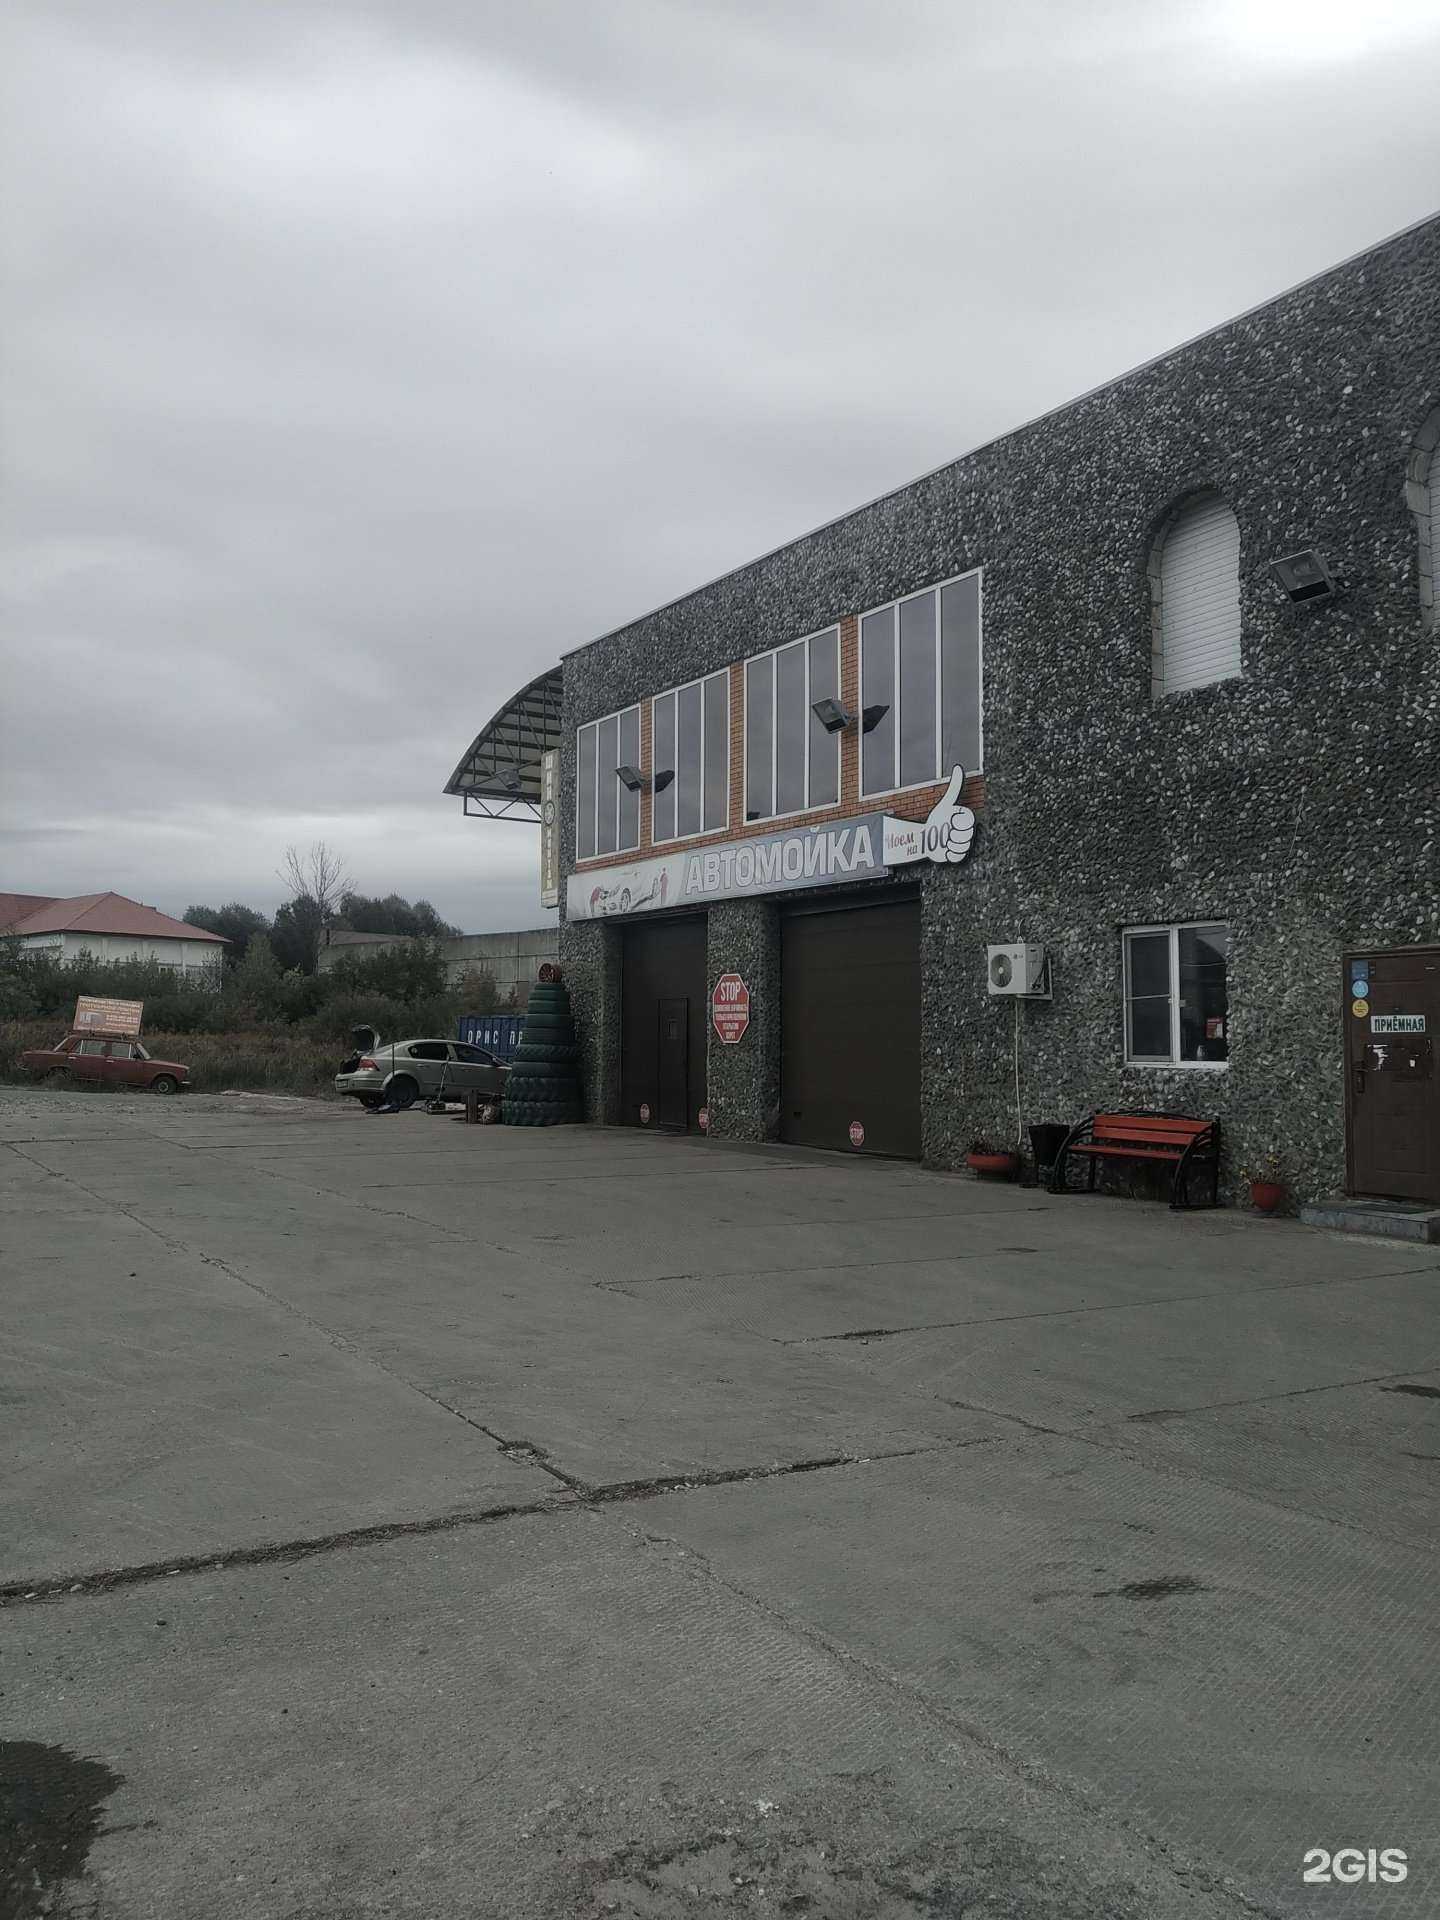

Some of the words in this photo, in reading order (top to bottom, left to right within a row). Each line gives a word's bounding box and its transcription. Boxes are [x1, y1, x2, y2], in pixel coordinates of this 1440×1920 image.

[685, 825, 875, 895] АВТОМОЙКА
[720, 981, 741, 1002] STOP
[1374, 1016, 1424, 1031] ПРИЁМНАЯ
